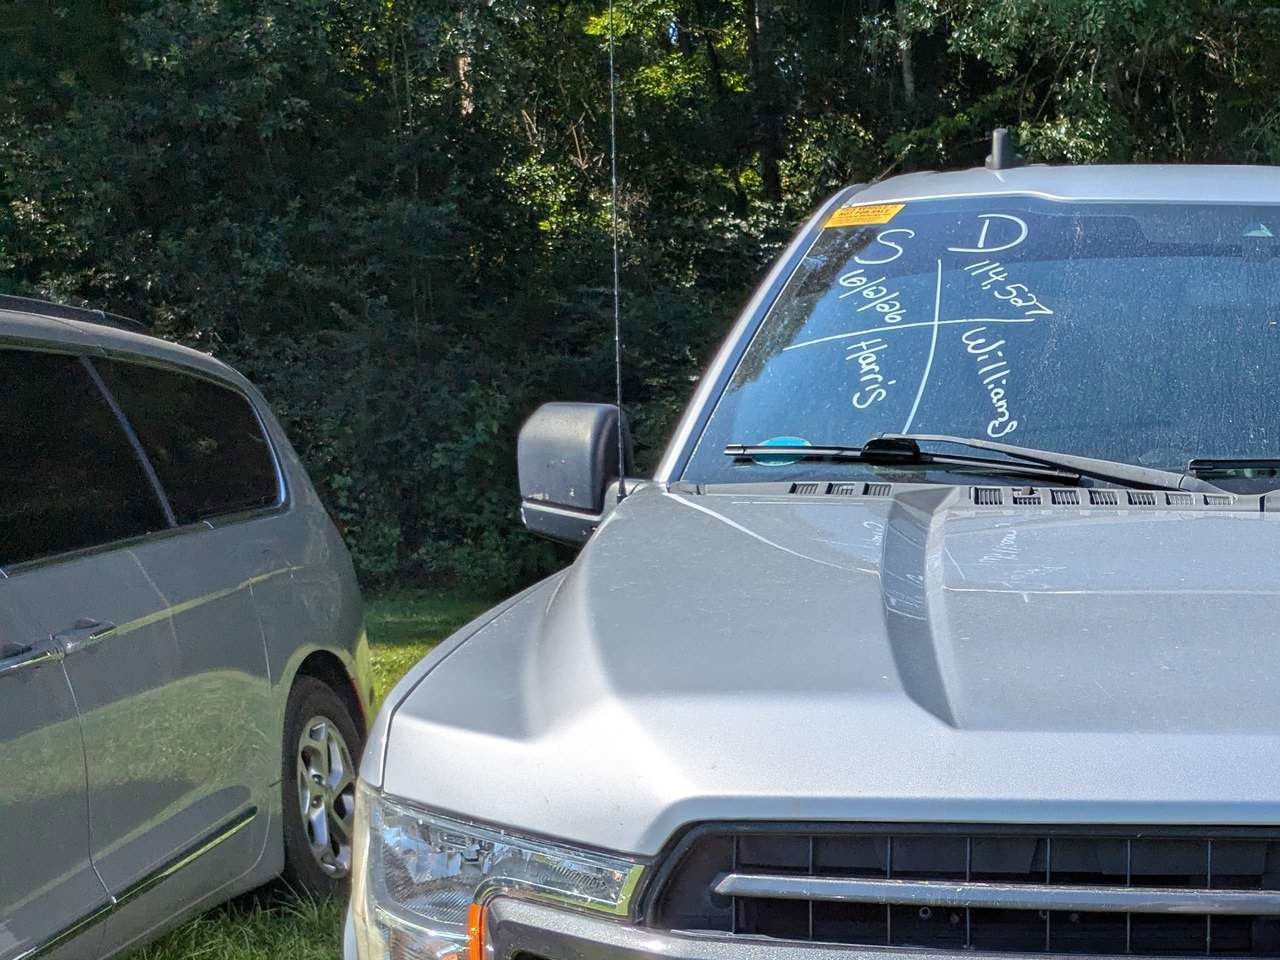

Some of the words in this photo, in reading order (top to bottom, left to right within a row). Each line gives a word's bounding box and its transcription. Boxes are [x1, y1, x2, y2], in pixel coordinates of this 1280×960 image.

[854, 229, 915, 264] S
[947, 213, 1028, 253] D
[962, 327, 1018, 438] Williams
